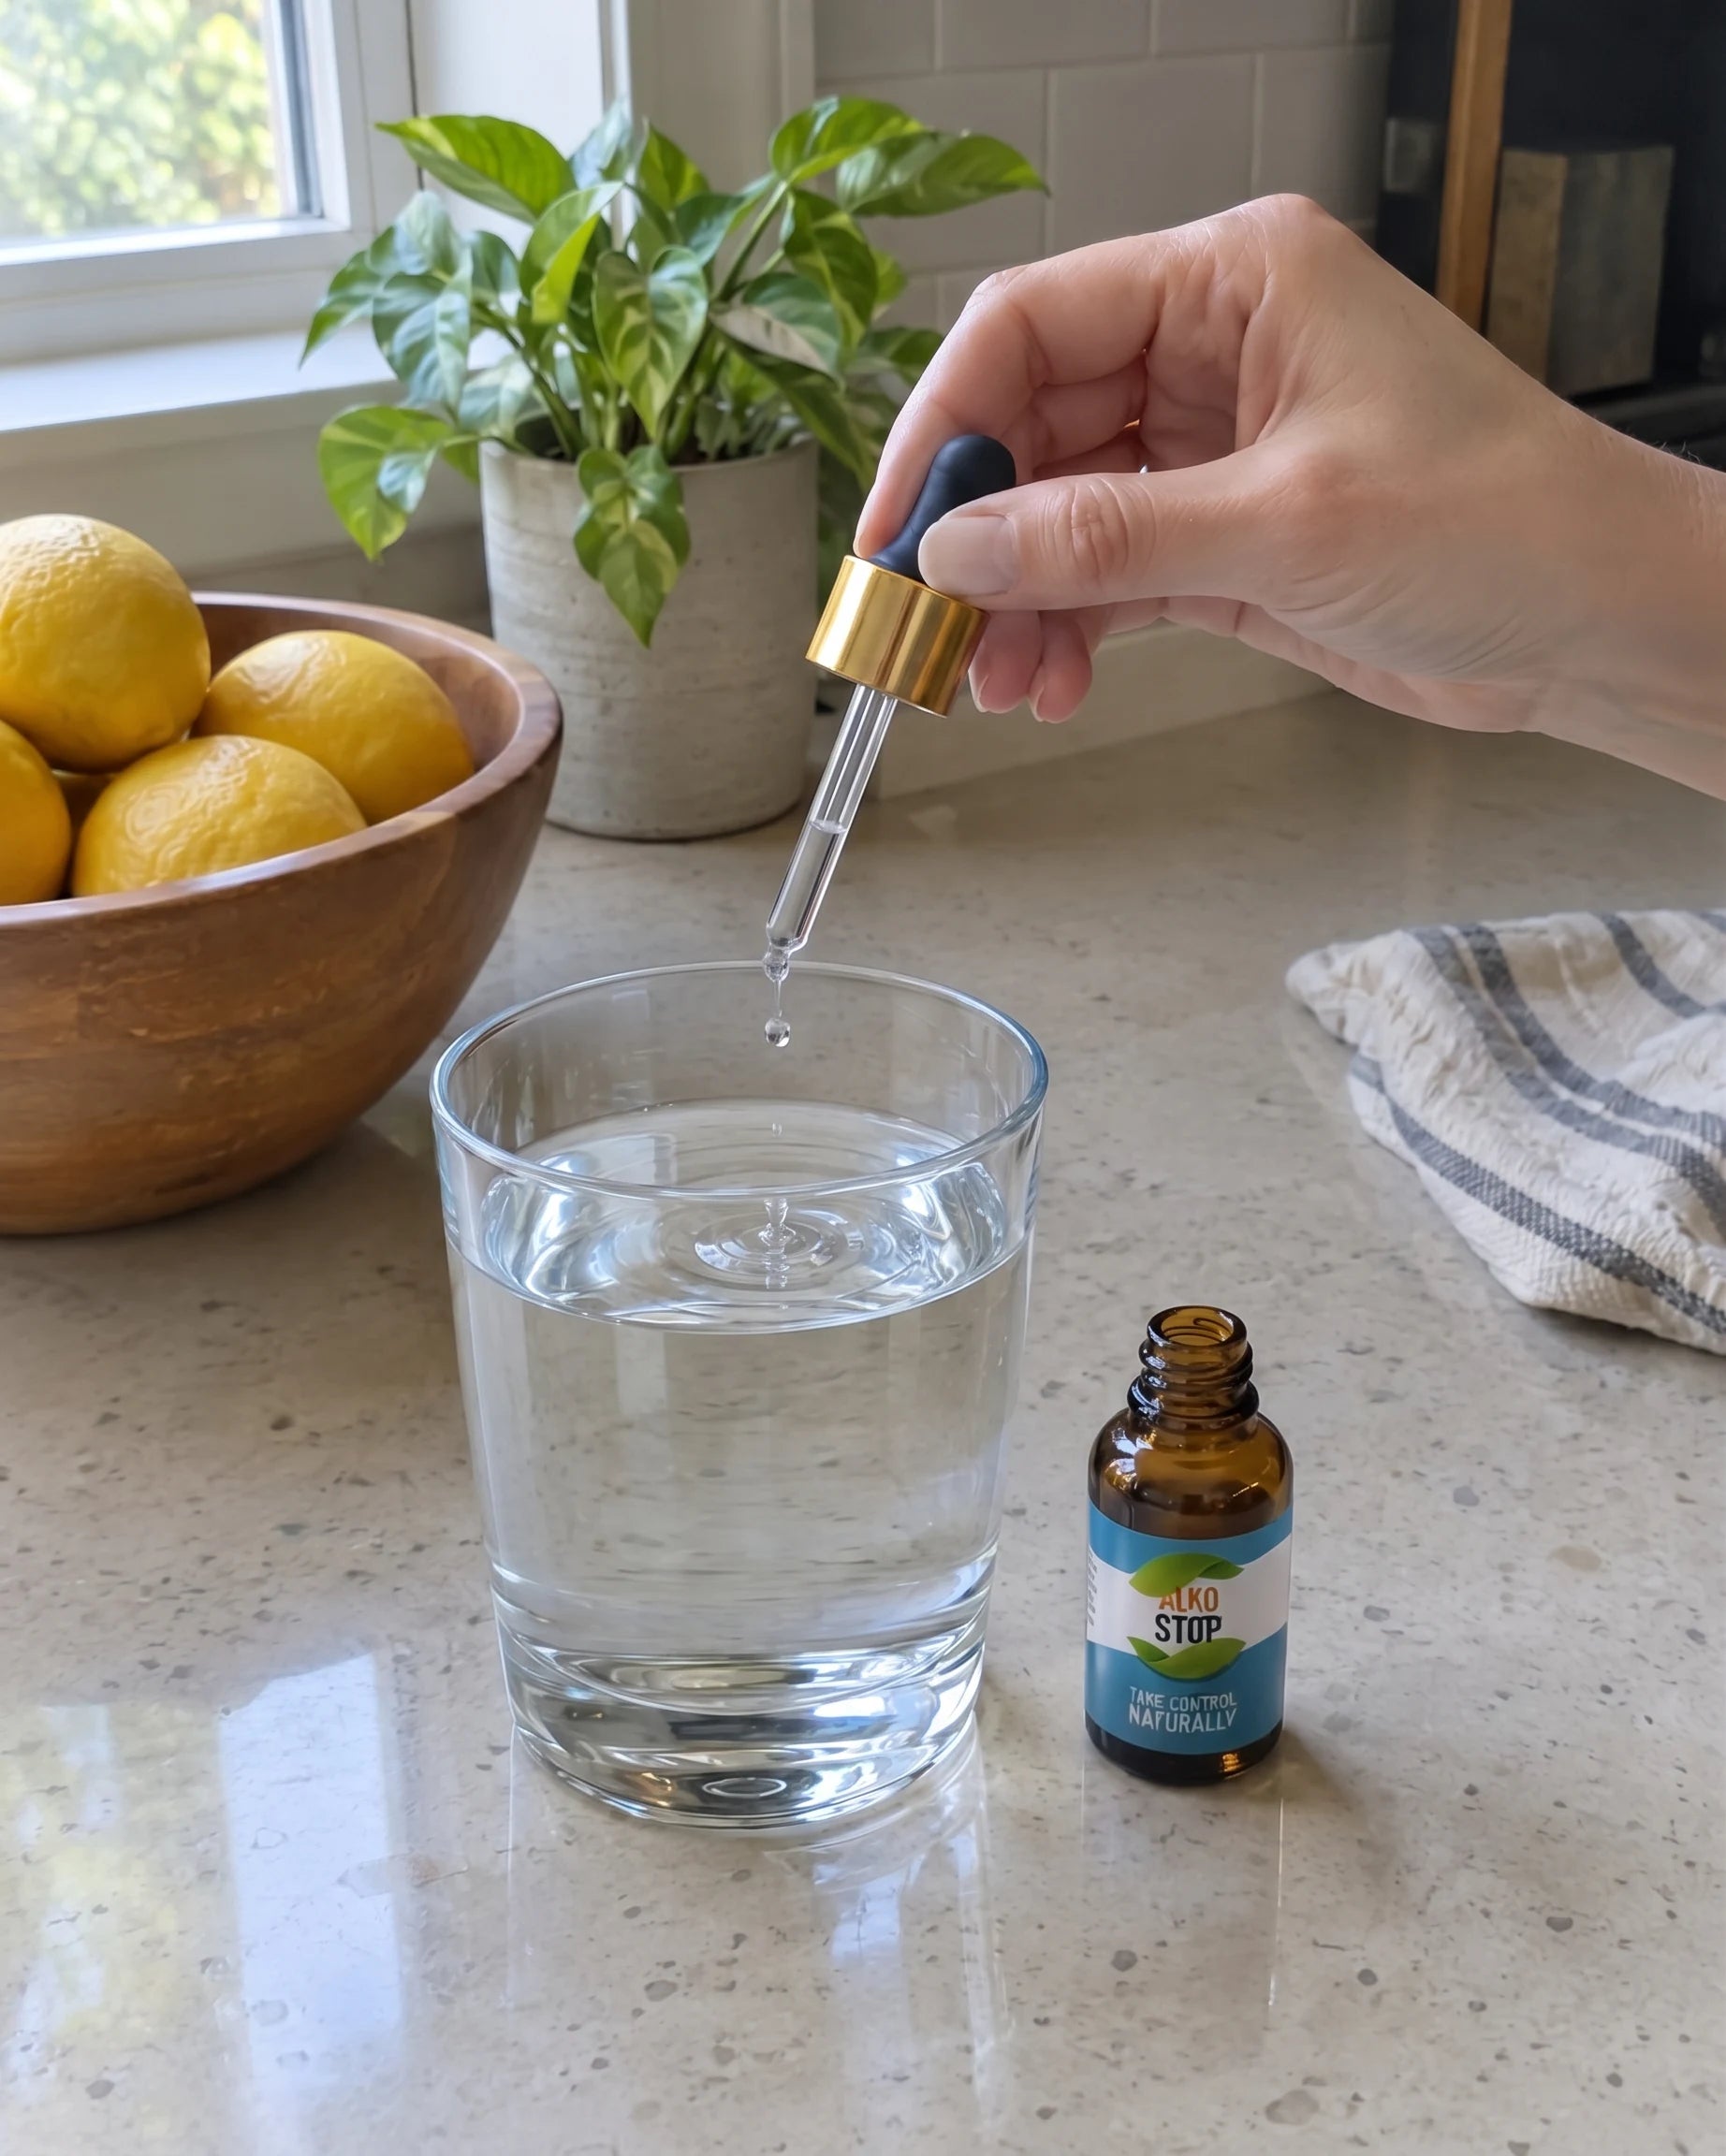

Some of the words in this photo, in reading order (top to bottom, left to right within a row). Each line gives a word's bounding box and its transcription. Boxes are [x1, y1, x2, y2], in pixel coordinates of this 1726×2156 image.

[1159, 1586, 1219, 1612] ALKO
[1155, 1613, 1222, 1644] STOP
[1130, 1686, 1165, 1709] TAKE
[1169, 1692, 1237, 1712] CONTROL
[1129, 1703, 1237, 1733] NATURALLY
